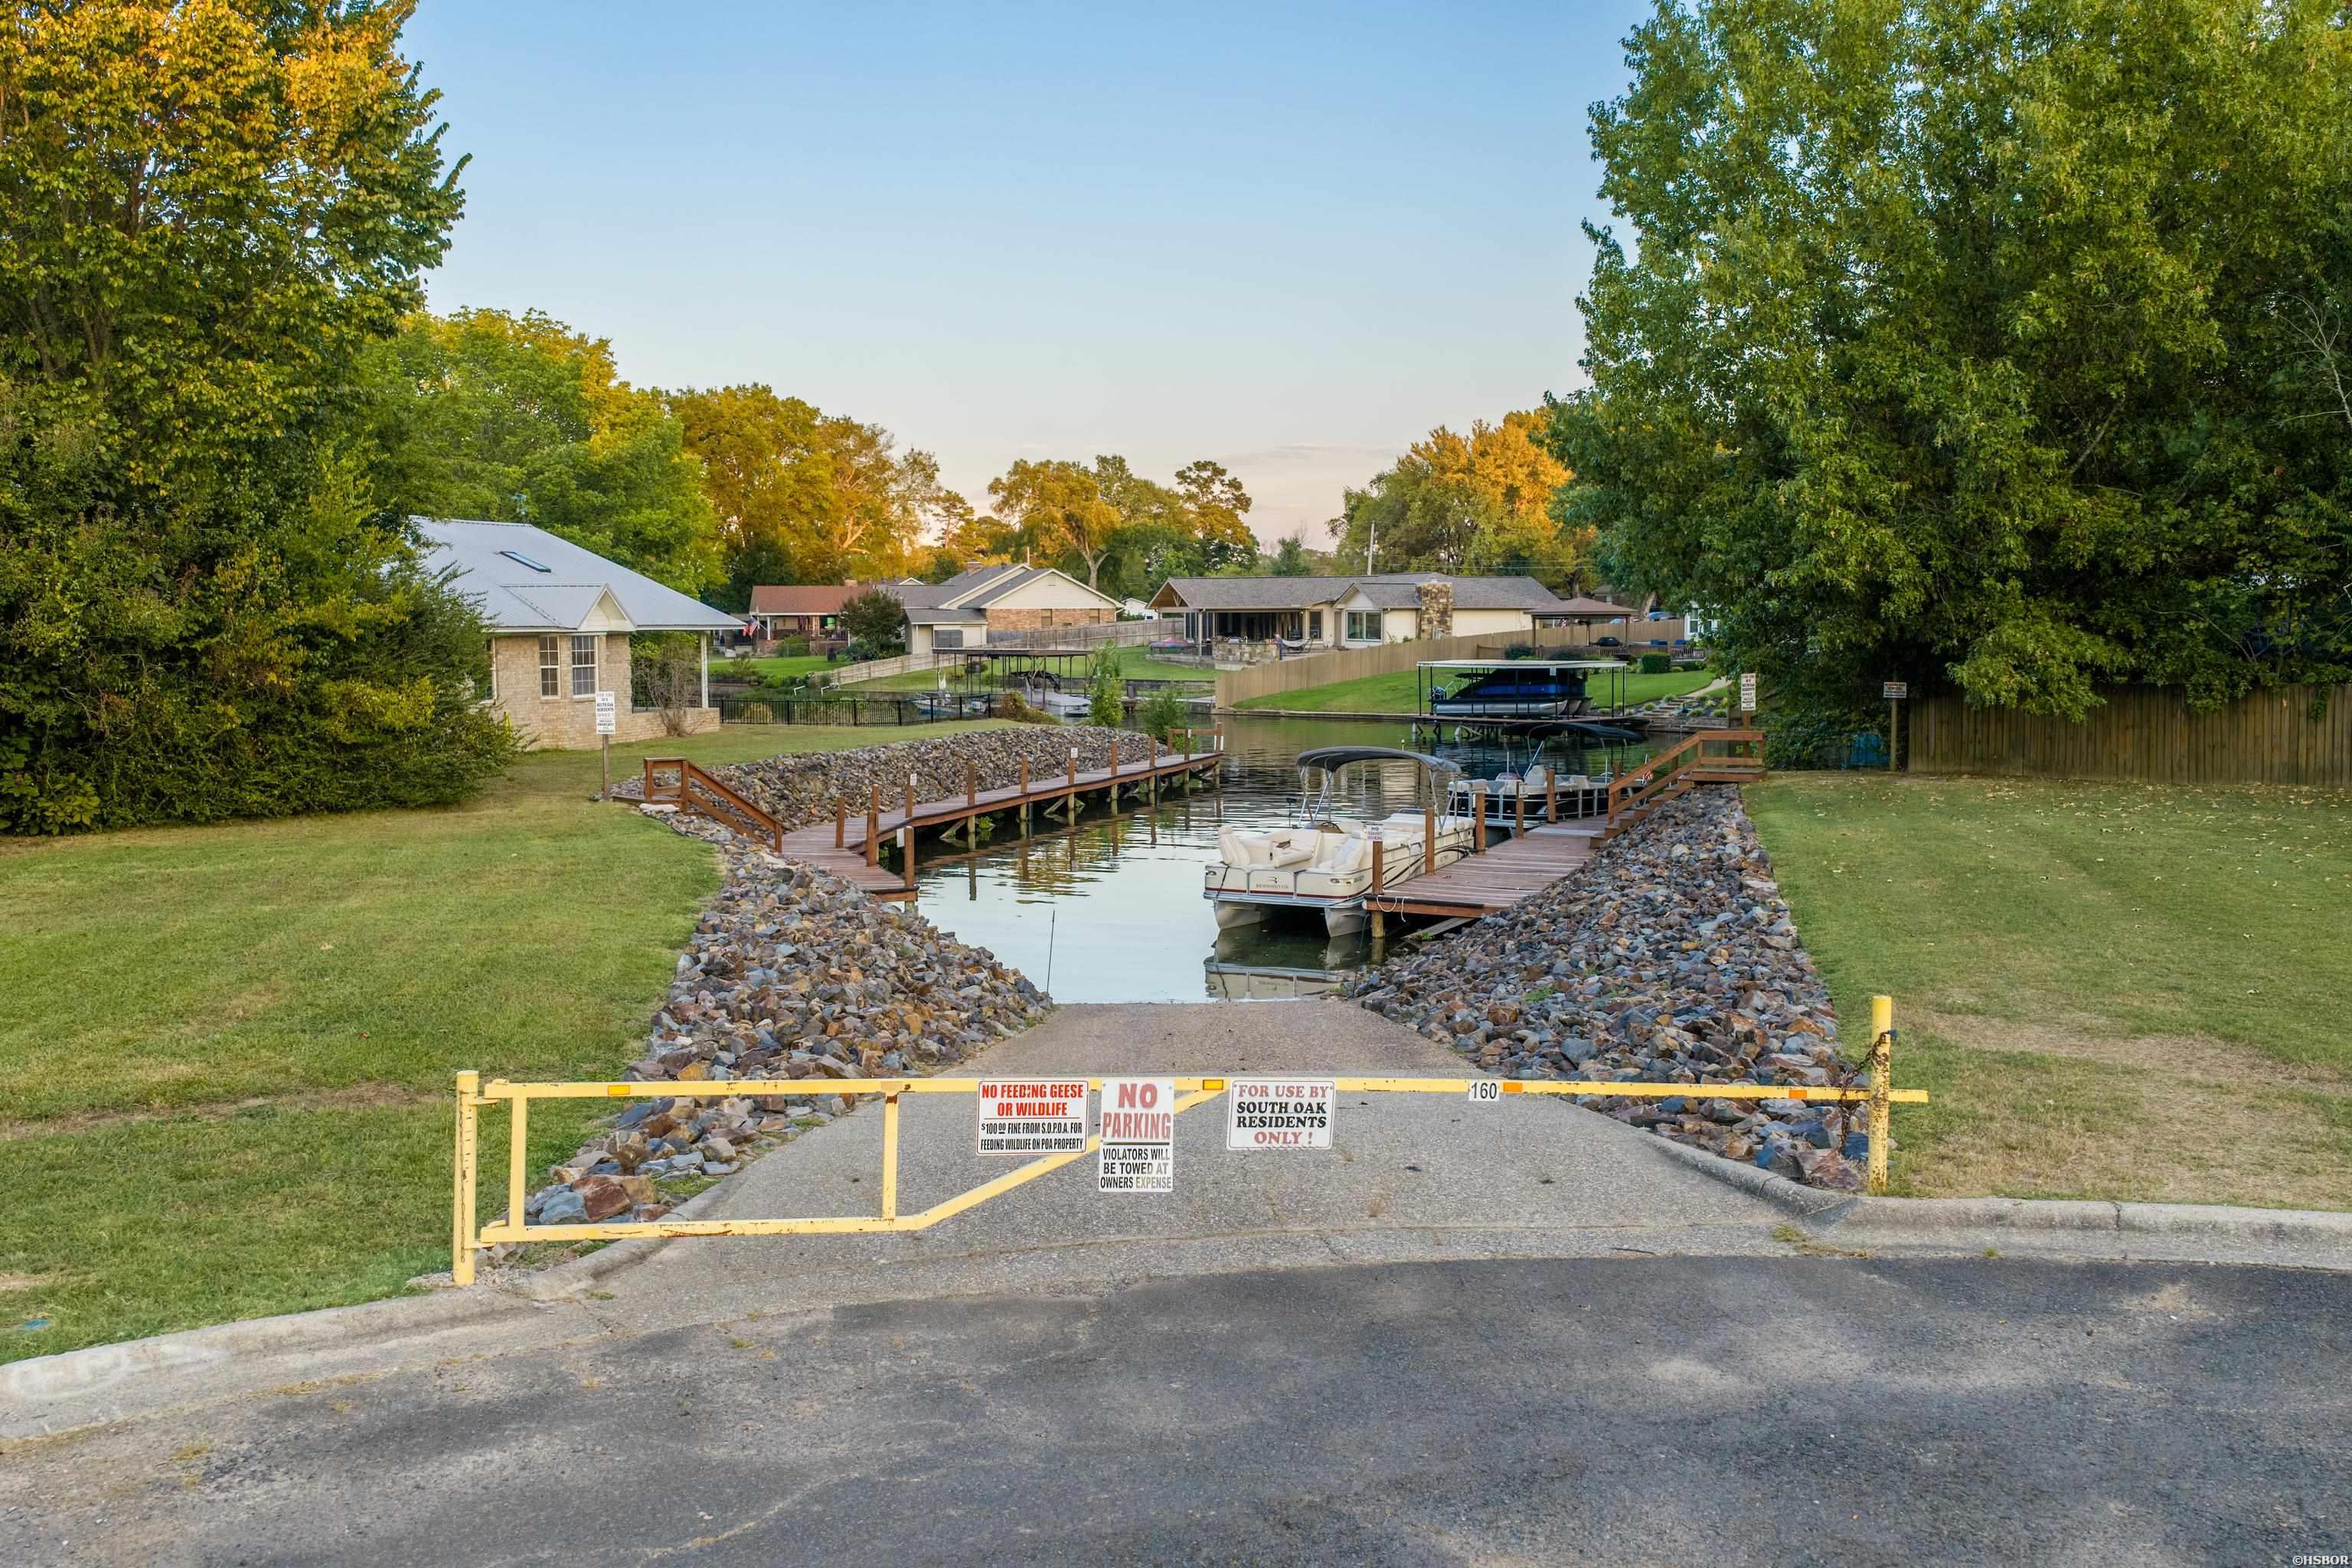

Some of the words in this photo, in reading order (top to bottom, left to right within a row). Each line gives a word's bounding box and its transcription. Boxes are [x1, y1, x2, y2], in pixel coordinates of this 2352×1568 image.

[982, 1084, 998, 1098] NO
[1001, 1084, 1047, 1098] FEEDING
[1050, 1084, 1083, 1098] GEESE
[1118, 1083, 1158, 1109] NO
[1239, 1084, 1269, 1097] FOR
[1275, 1086, 1305, 1098] USE
[1309, 1086, 1328, 1098] BY
[1472, 1082, 1497, 1099] 160
[998, 1102, 1013, 1116] OR
[1016, 1102, 1067, 1116] WILDLIFE
[1236, 1102, 1288, 1113] SOUTH
[1294, 1102, 1327, 1113] OAK
[1008, 1122, 1021, 1134] FINE
[1023, 1122, 1040, 1134] FROM
[1070, 1122, 1082, 1134] FOR
[1102, 1112, 1171, 1140] PARKING
[1236, 1116, 1327, 1128] RESIDENTS
[981, 1138, 1004, 1150] FEEDING
[1005, 1138, 1031, 1150] WILDLIFE
[1032, 1138, 1040, 1150] ON
[1041, 1138, 1053, 1150] POA
[1054, 1138, 1083, 1149] PROPERTY
[1254, 1132, 1302, 1144] ONLY
[1102, 1148, 1148, 1160] VIOLATORS
[1151, 1148, 1170, 1160] WILL
[1103, 1162, 1116, 1174] BE
[1119, 1162, 1153, 1174] TOWED
[1156, 1162, 1168, 1174] AT
[1100, 1177, 1133, 1188] OWNERS
[1135, 1177, 1171, 1189] EXPENSE
